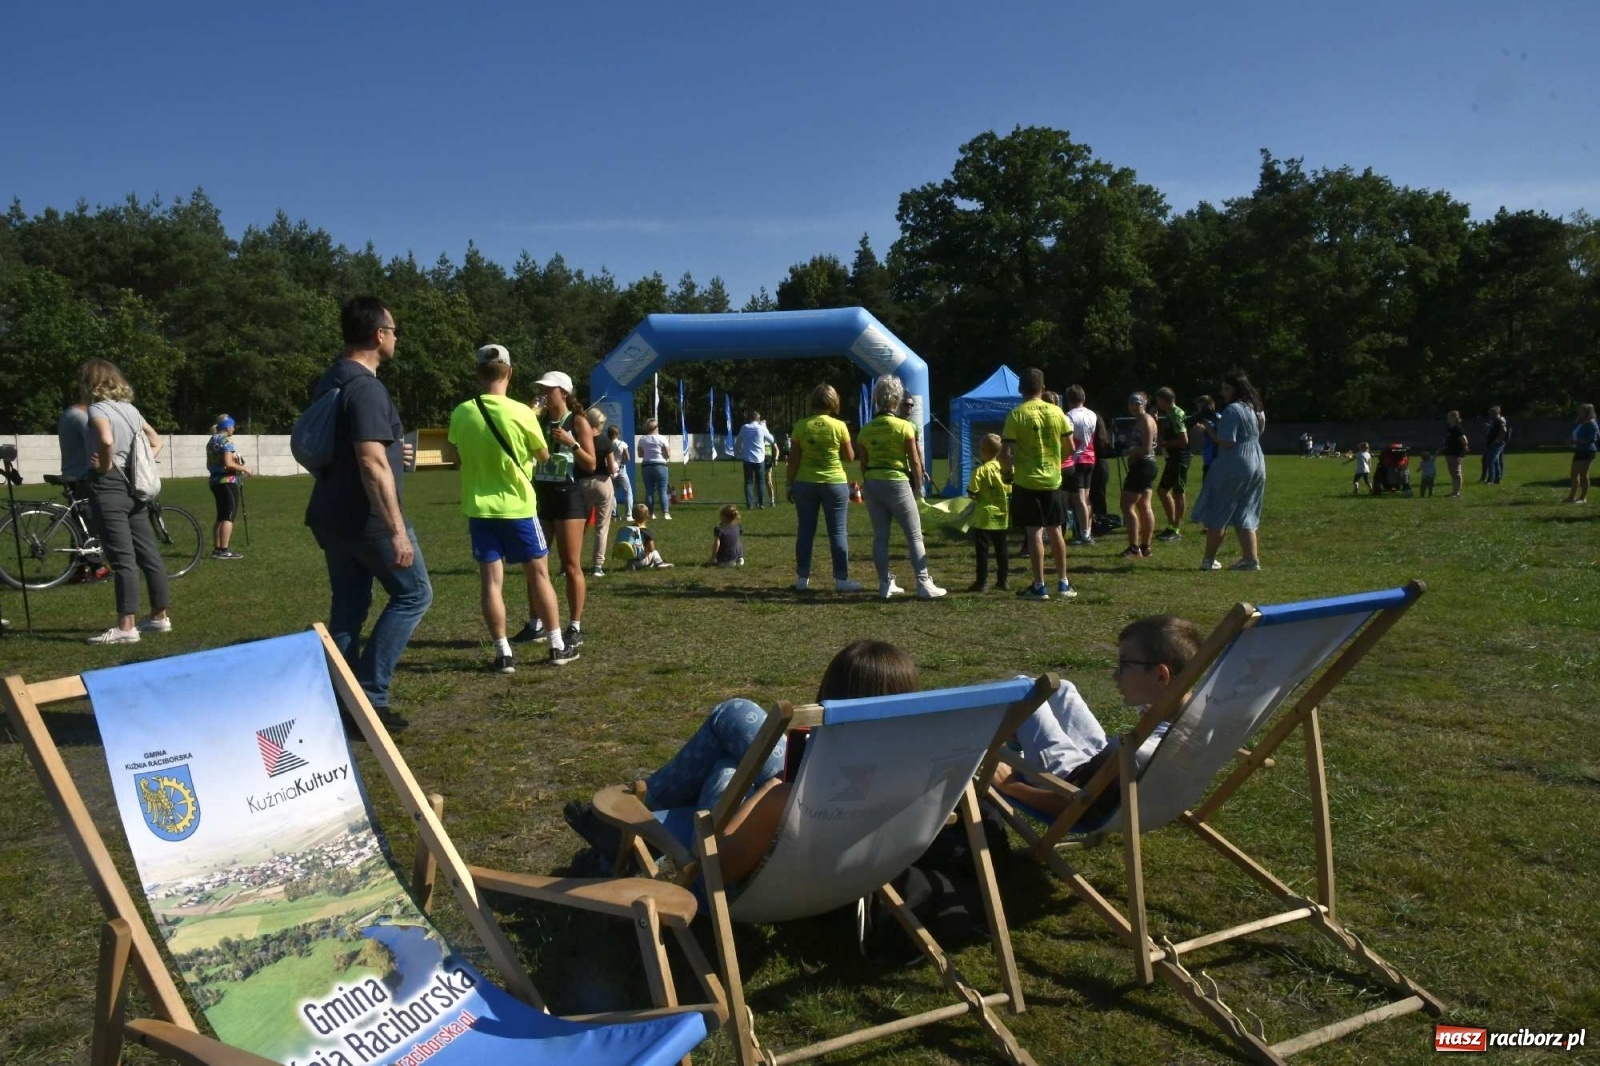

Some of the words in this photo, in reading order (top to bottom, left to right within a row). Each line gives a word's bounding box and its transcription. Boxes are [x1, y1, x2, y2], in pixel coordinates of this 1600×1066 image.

[143, 749, 167, 759] GMINA
[147, 752, 193, 767] RACIBORSKA
[246, 763, 348, 814] KuźniaKultury
[303, 978, 389, 1035] Gmina
[343, 966, 477, 1063] Raciborska
